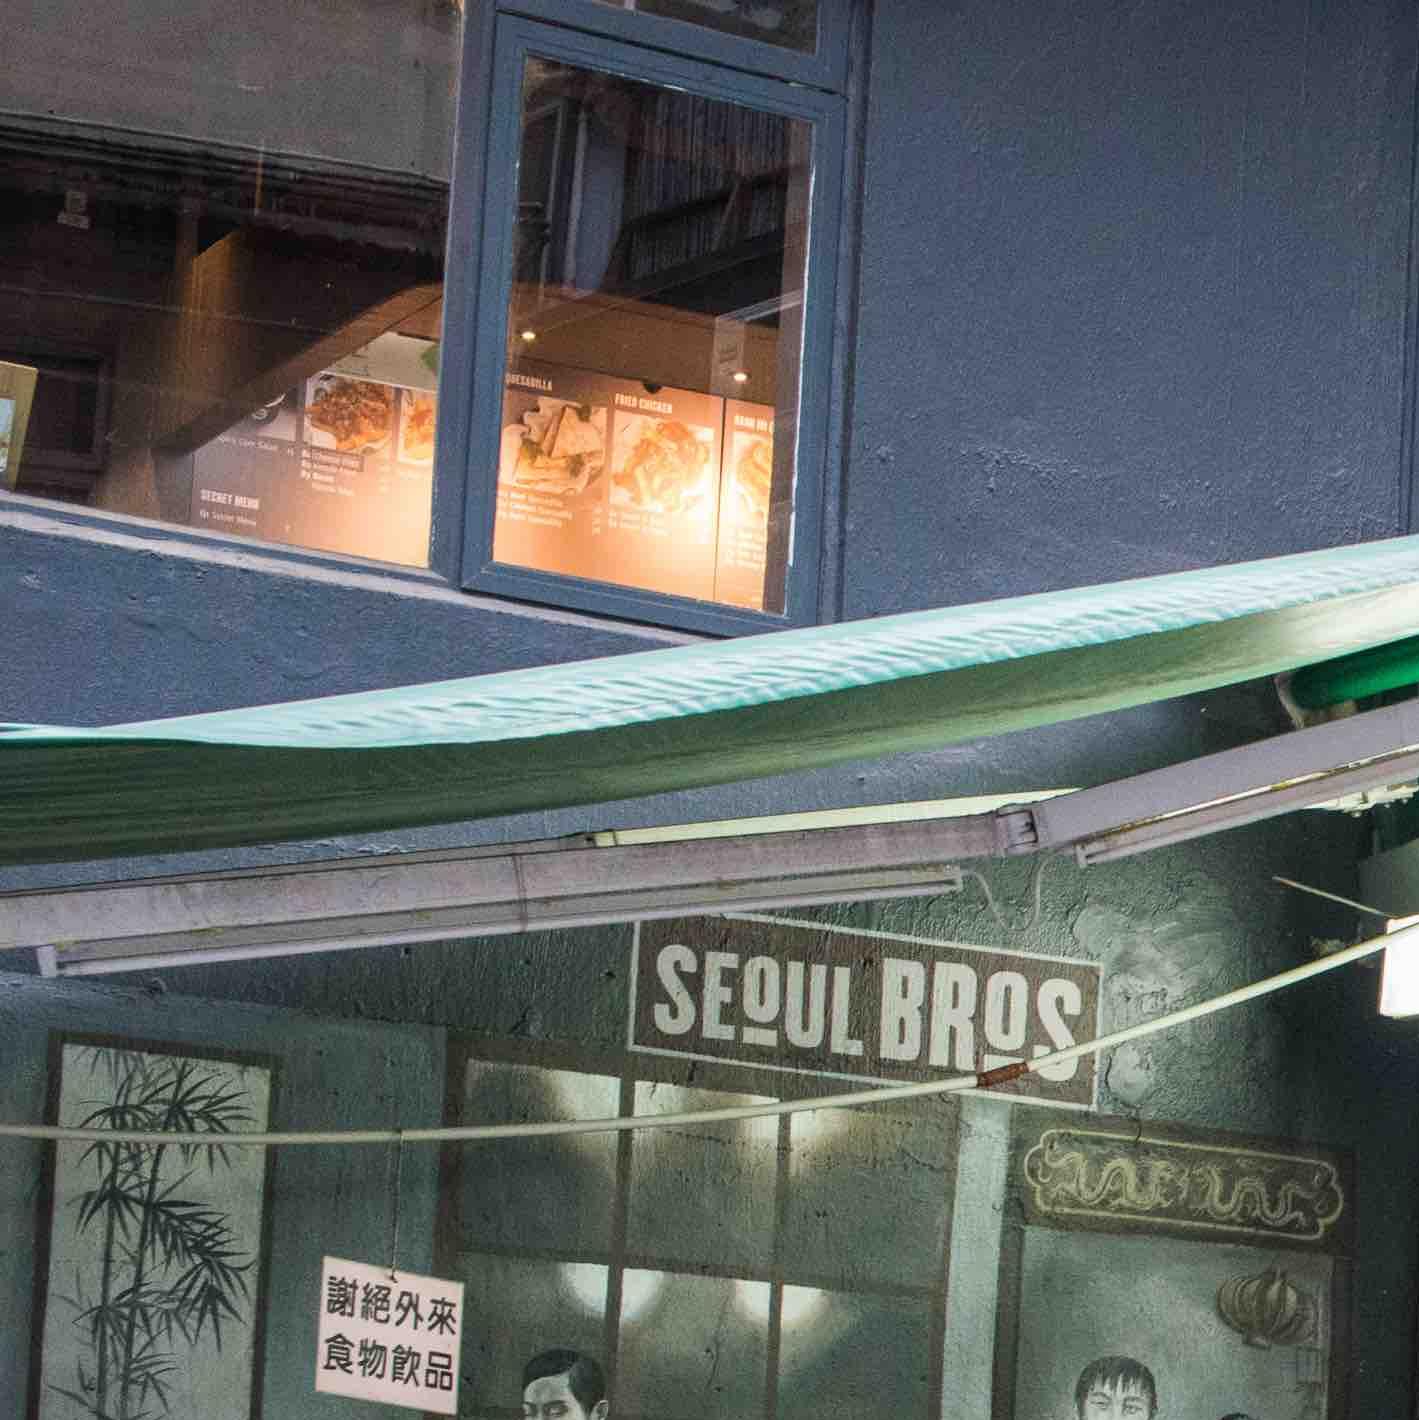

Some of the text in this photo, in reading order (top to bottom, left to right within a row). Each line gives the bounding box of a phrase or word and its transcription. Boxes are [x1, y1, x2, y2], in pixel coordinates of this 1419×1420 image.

[200, 489, 232, 505] SECRET
[653, 943, 1082, 1083] SEOUL BROS
[321, 1331, 455, 1392] 食物飲品
